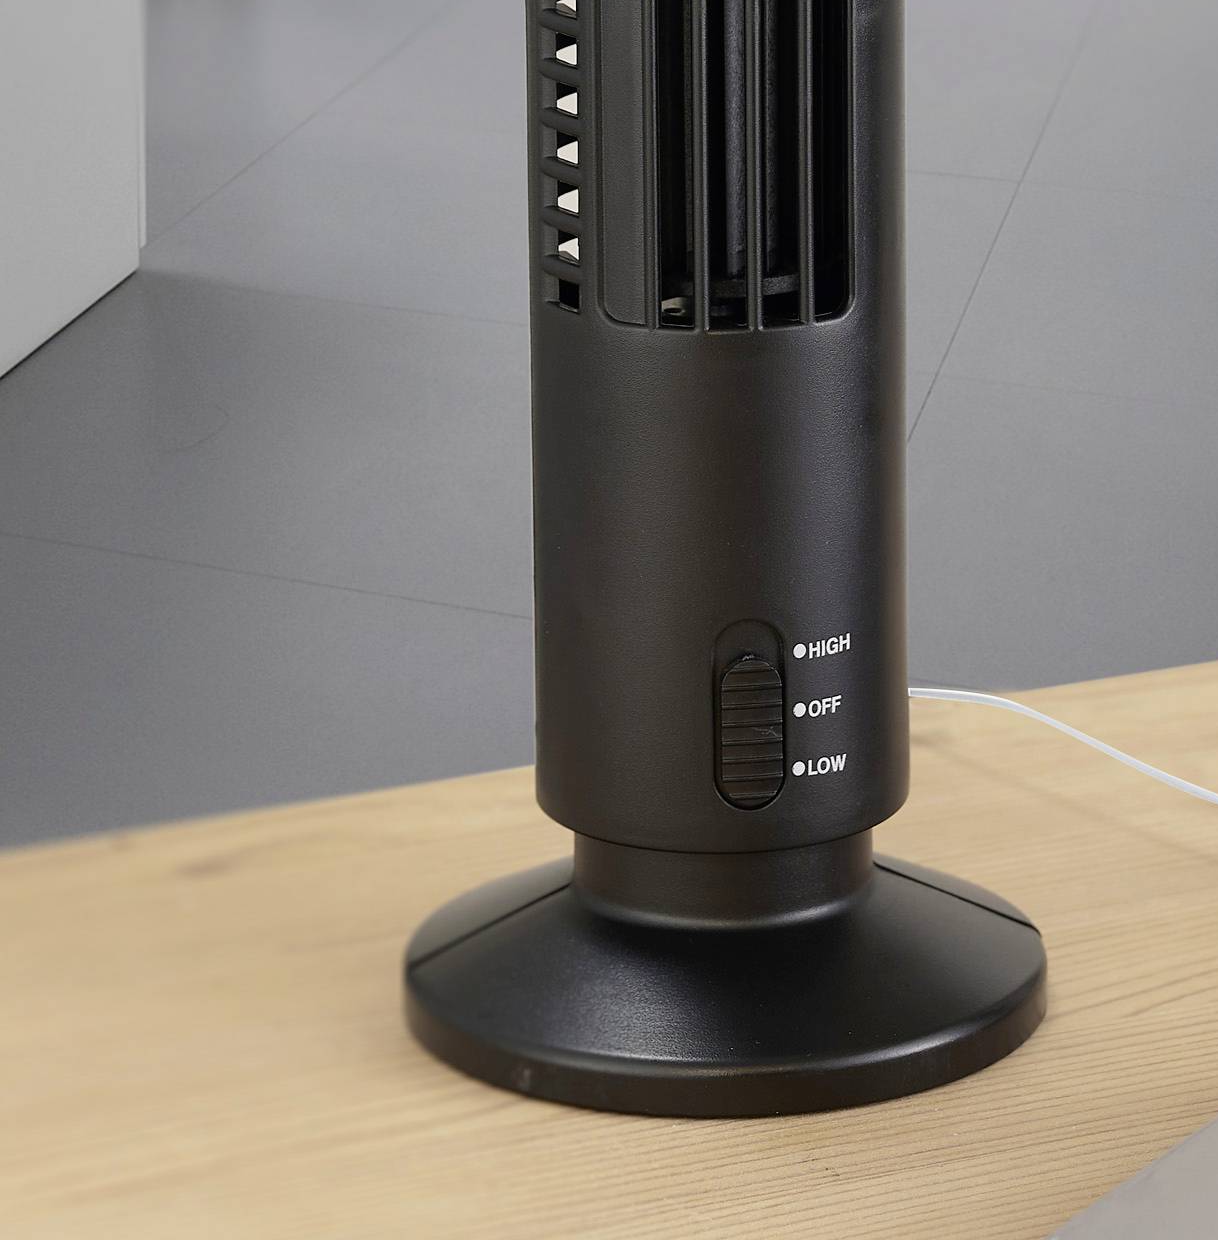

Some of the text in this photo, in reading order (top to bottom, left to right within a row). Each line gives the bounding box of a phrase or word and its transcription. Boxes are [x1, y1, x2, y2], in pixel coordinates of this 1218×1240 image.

[808, 633, 851, 659] HIGH
[808, 695, 842, 718] OFF
[807, 753, 847, 776] LOW
